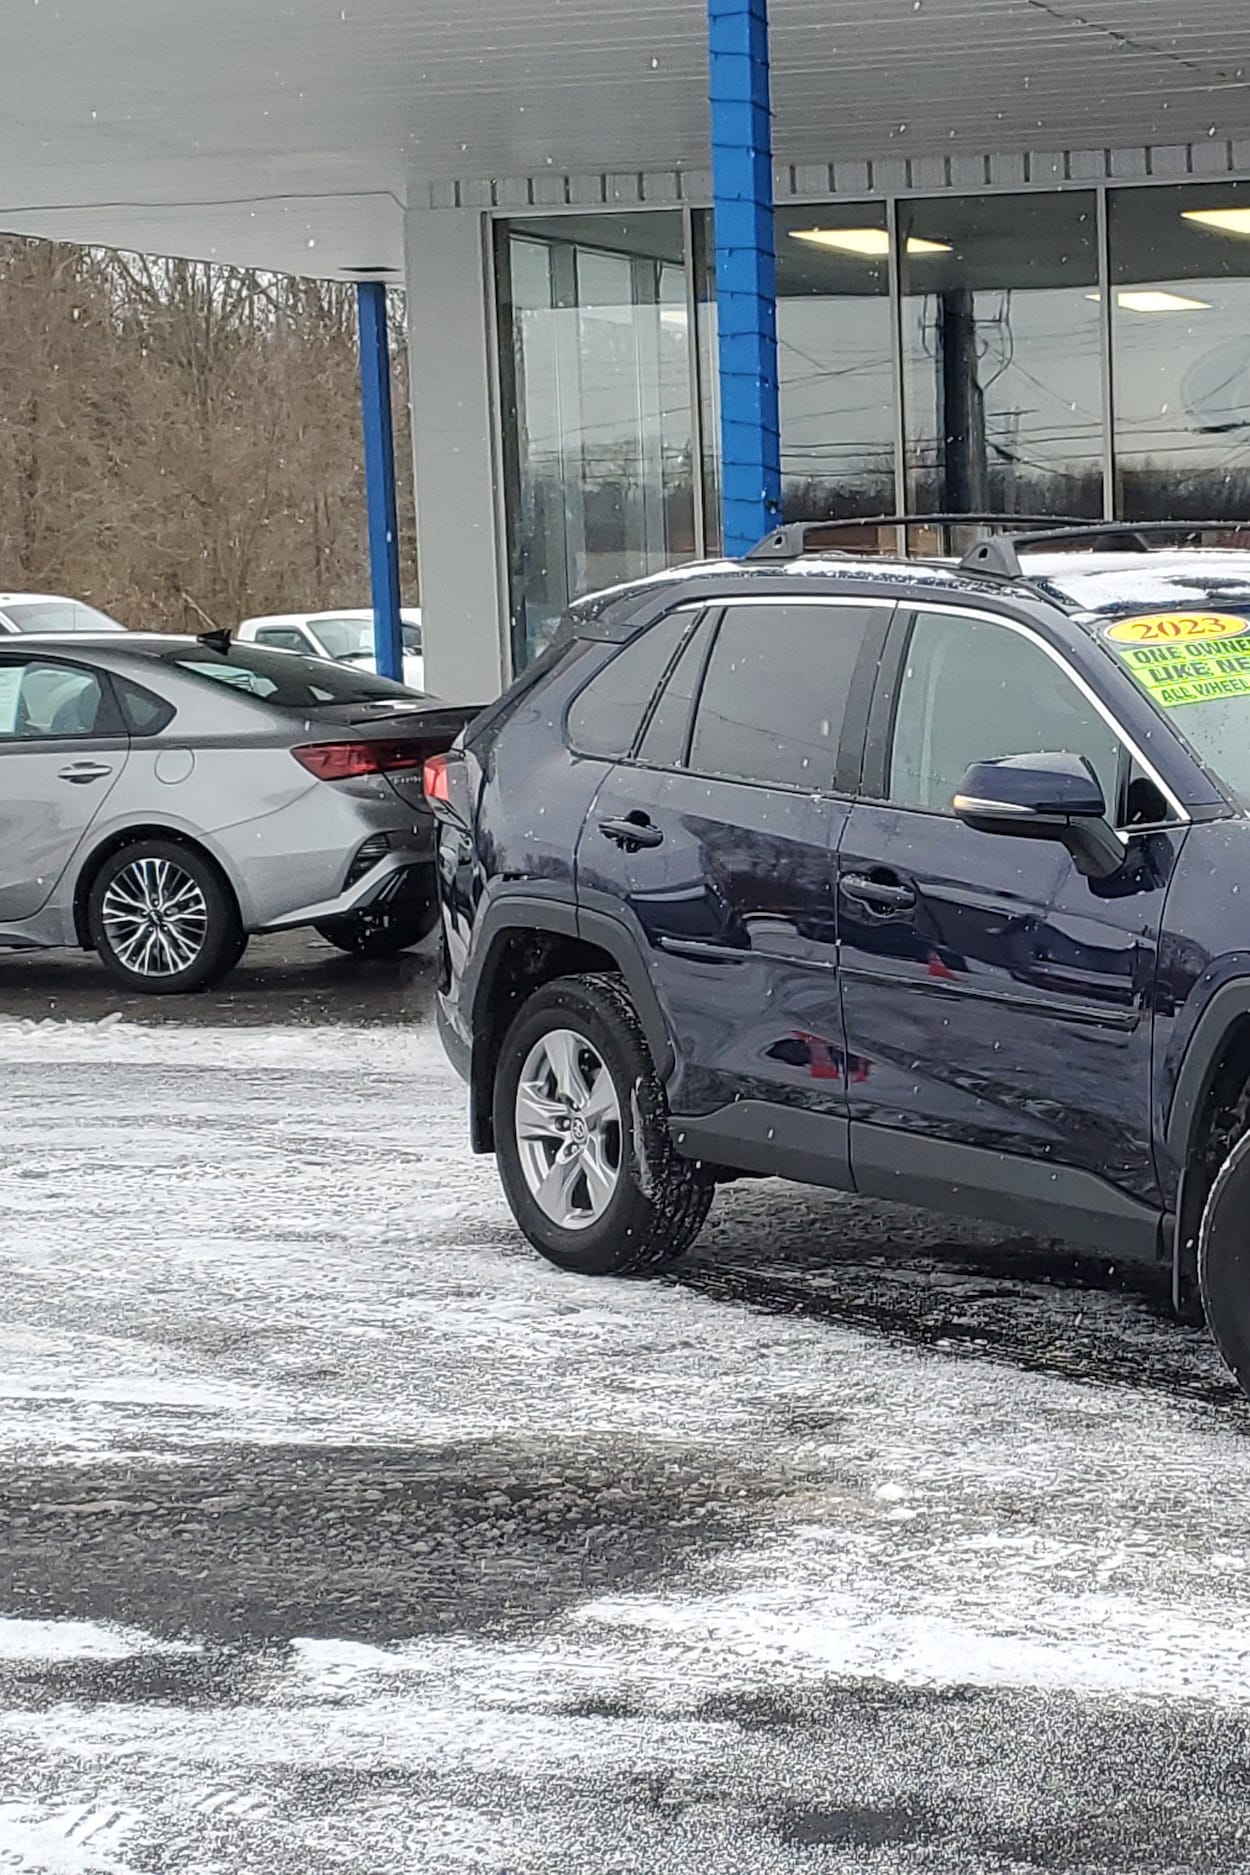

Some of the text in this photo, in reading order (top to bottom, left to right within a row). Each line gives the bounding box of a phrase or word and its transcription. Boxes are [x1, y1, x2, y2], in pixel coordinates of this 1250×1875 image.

[1132, 617, 1226, 640] 2023
[1133, 646, 1183, 664] ONE
[1148, 661, 1211, 682] LIKE
[1162, 686, 1195, 702] ALL
[1194, 677, 1250, 696] WHEEL
